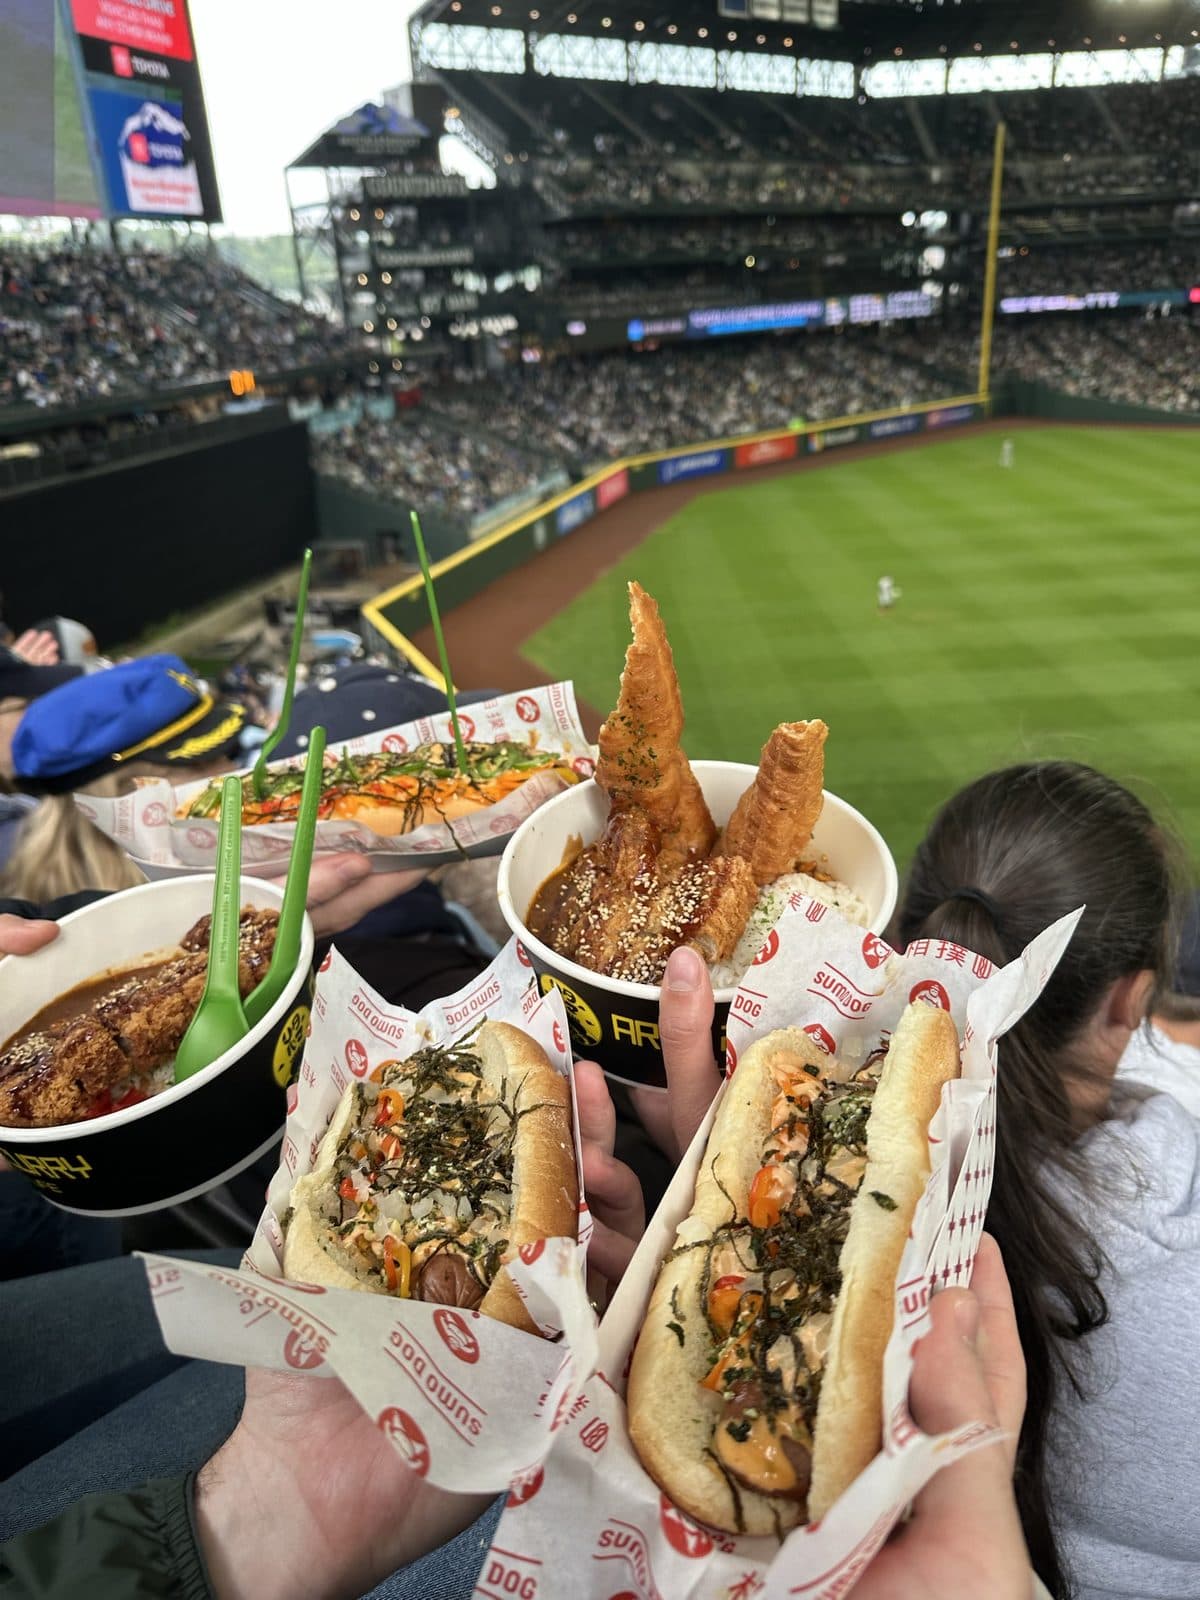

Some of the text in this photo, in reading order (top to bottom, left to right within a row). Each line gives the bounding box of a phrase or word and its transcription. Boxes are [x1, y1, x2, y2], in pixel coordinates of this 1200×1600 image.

[352, 994, 404, 1040] SUMO DOG
[446, 981, 501, 1026] SUMO DOG
[523, 990, 539, 1015] DOG
[734, 995, 762, 1018] DOG
[263, 1296, 331, 1353] SUMO
[390, 1331, 482, 1436] SUMO DOG
[487, 1560, 537, 1600] DOG
